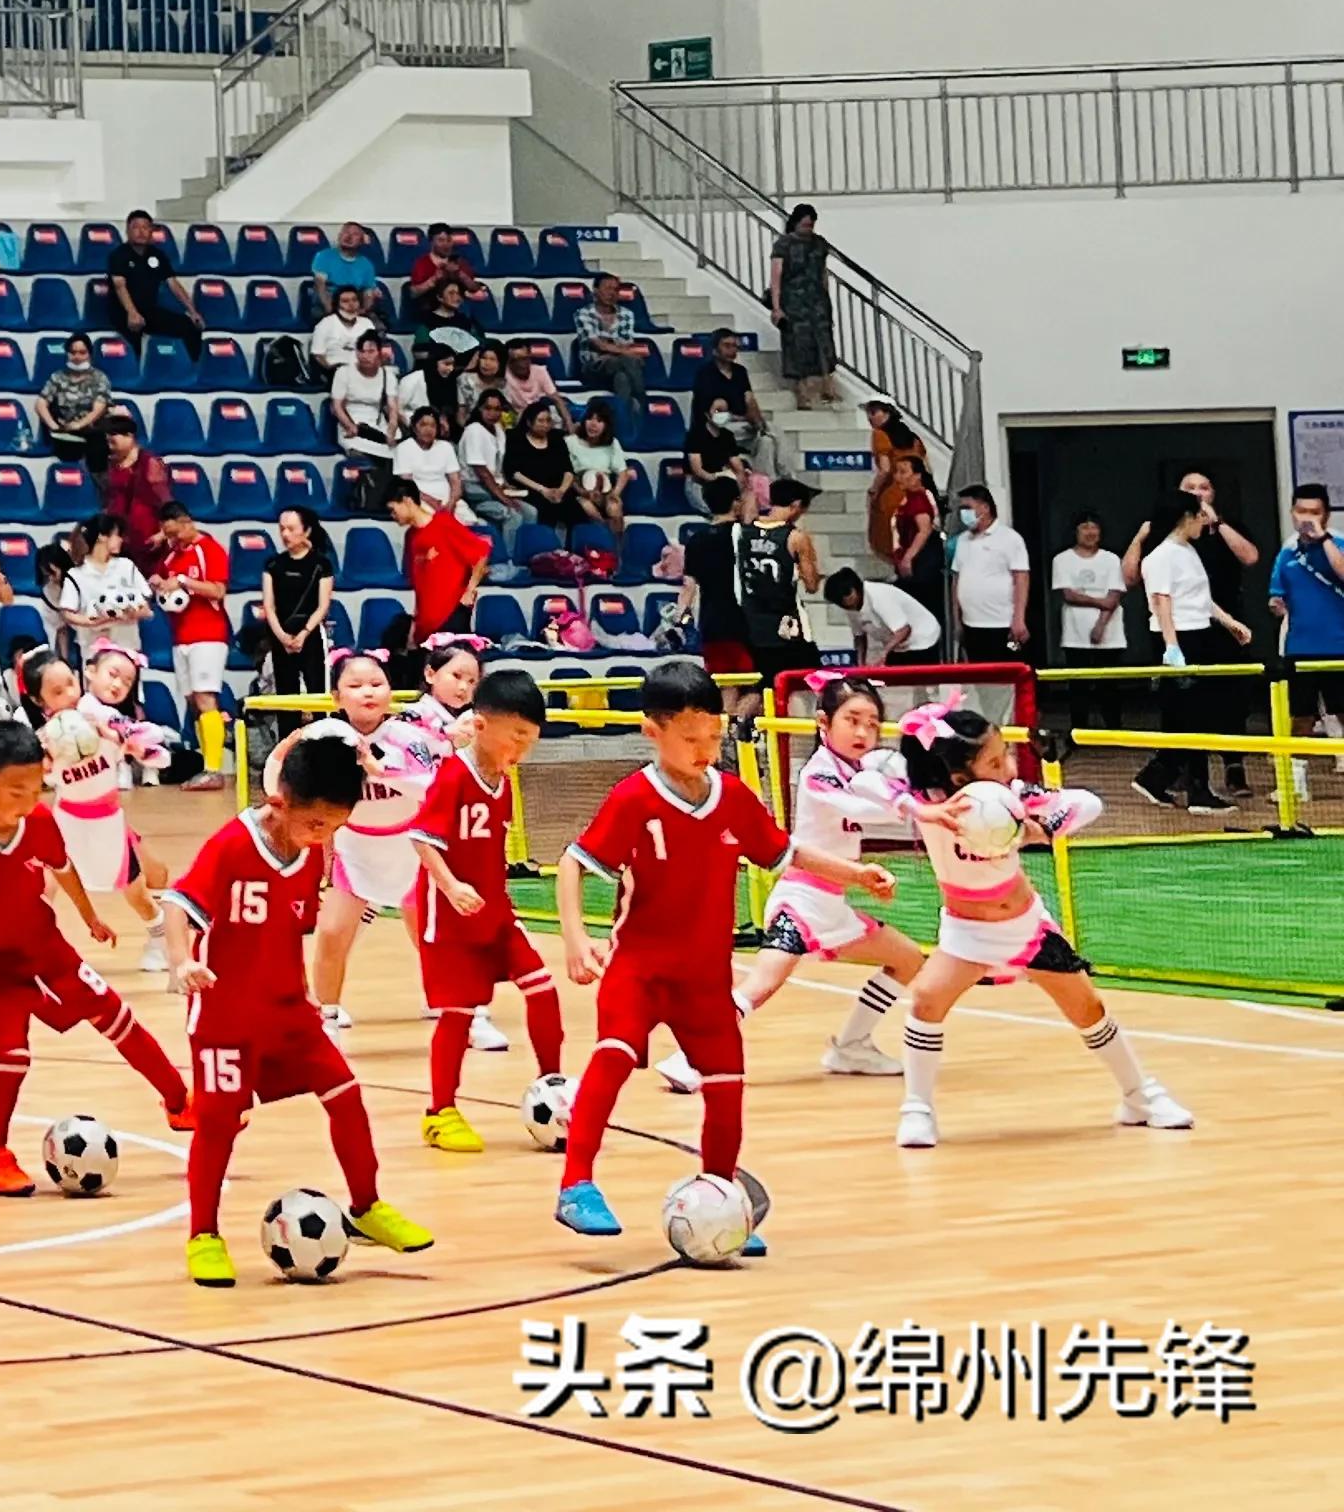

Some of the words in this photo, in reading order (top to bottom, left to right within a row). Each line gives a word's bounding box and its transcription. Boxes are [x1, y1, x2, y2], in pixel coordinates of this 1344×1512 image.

[62, 755, 110, 785] CHINA
[459, 802, 492, 840] 12
[646, 818, 667, 860] 1
[229, 880, 269, 925] 15
[78, 962, 109, 996] 8
[200, 1047, 242, 1093] 15
